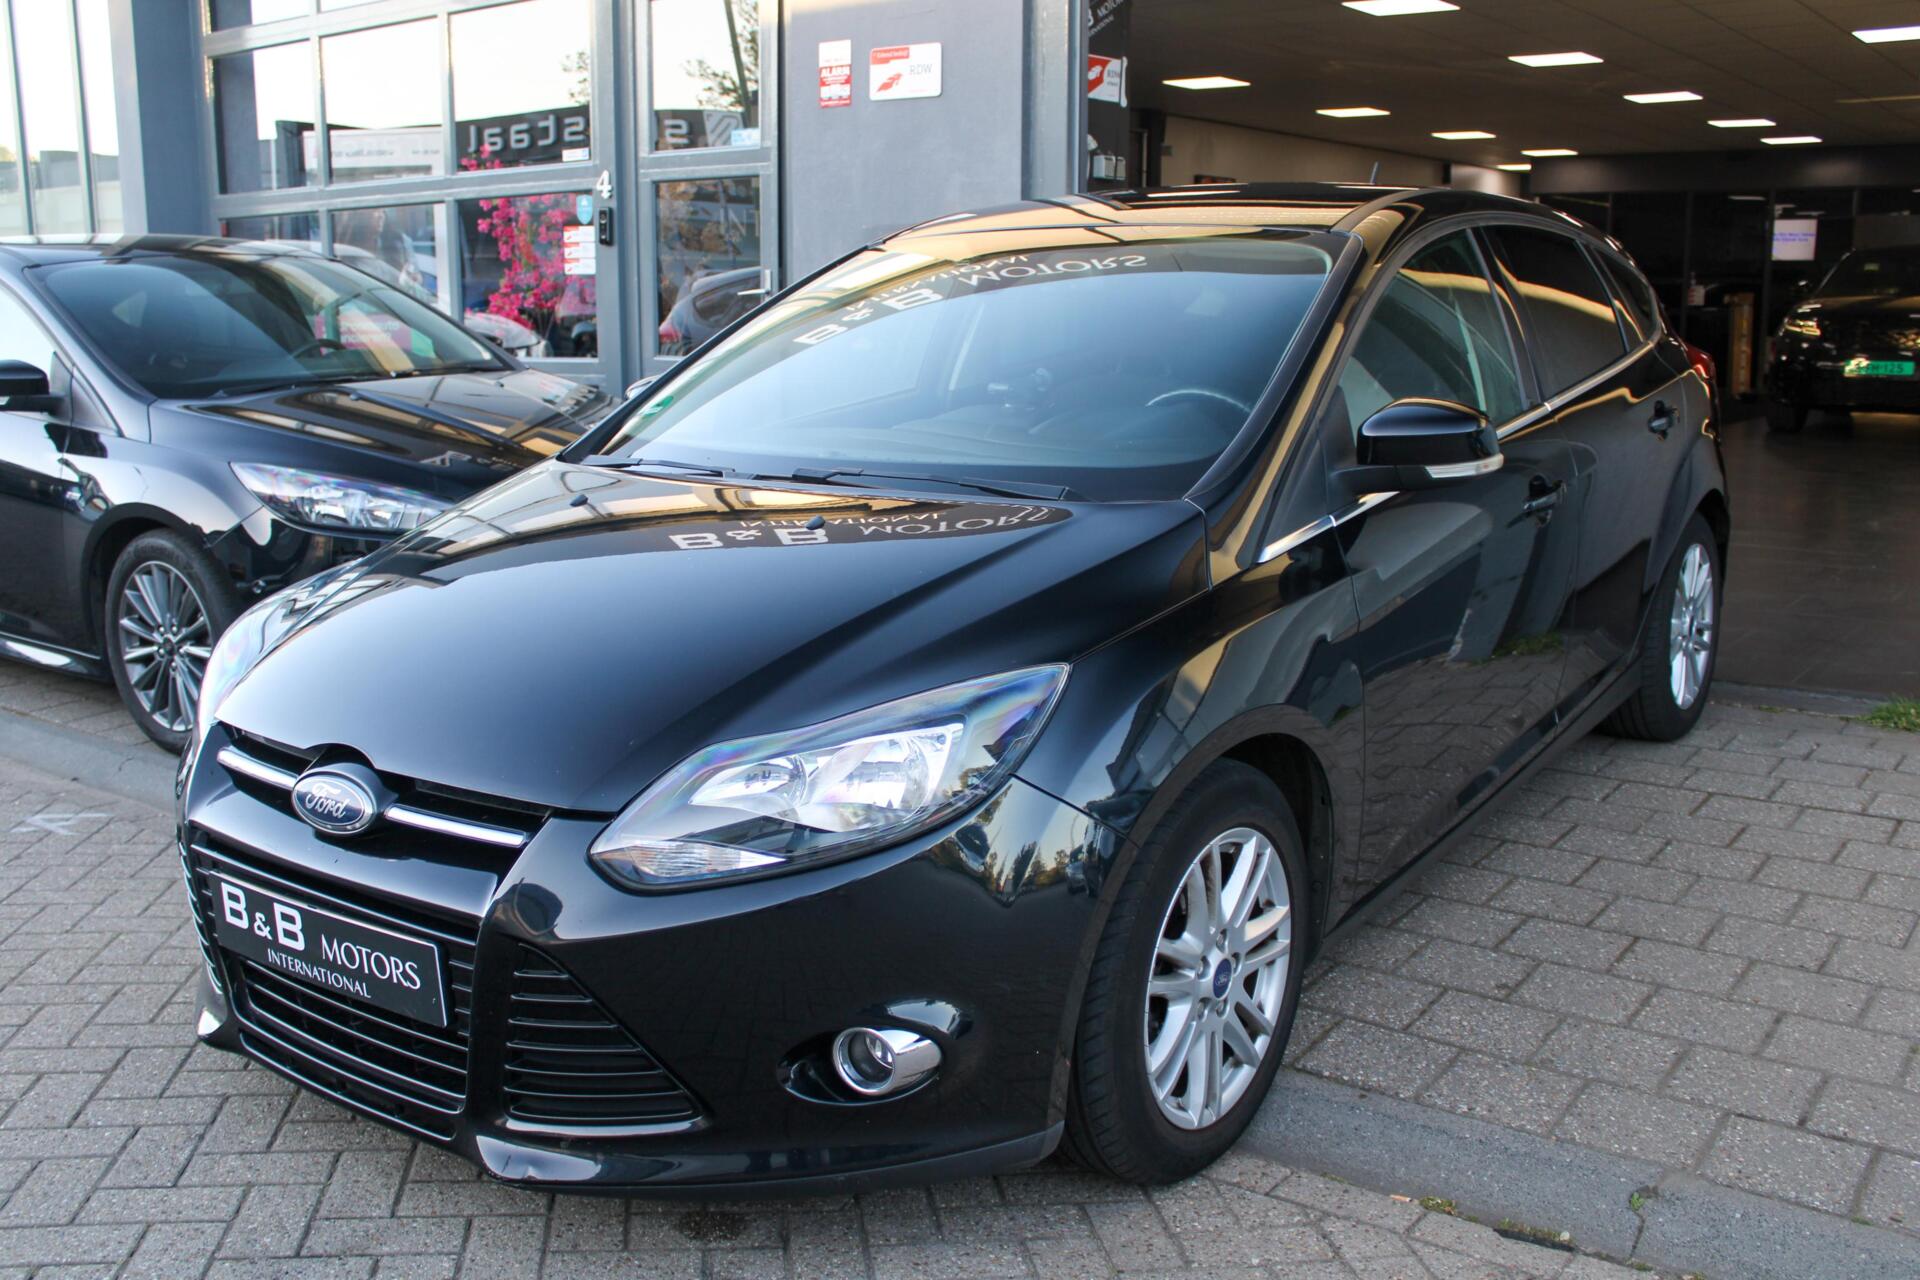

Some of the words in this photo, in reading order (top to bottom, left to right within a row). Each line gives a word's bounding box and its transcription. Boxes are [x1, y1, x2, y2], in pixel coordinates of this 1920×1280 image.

[909, 63, 933, 75] RDW
[596, 169, 612, 199] 4
[305, 782, 350, 819] Ford
[267, 948, 371, 999] INTERNATIONAL
[321, 934, 421, 990] MOTORS
